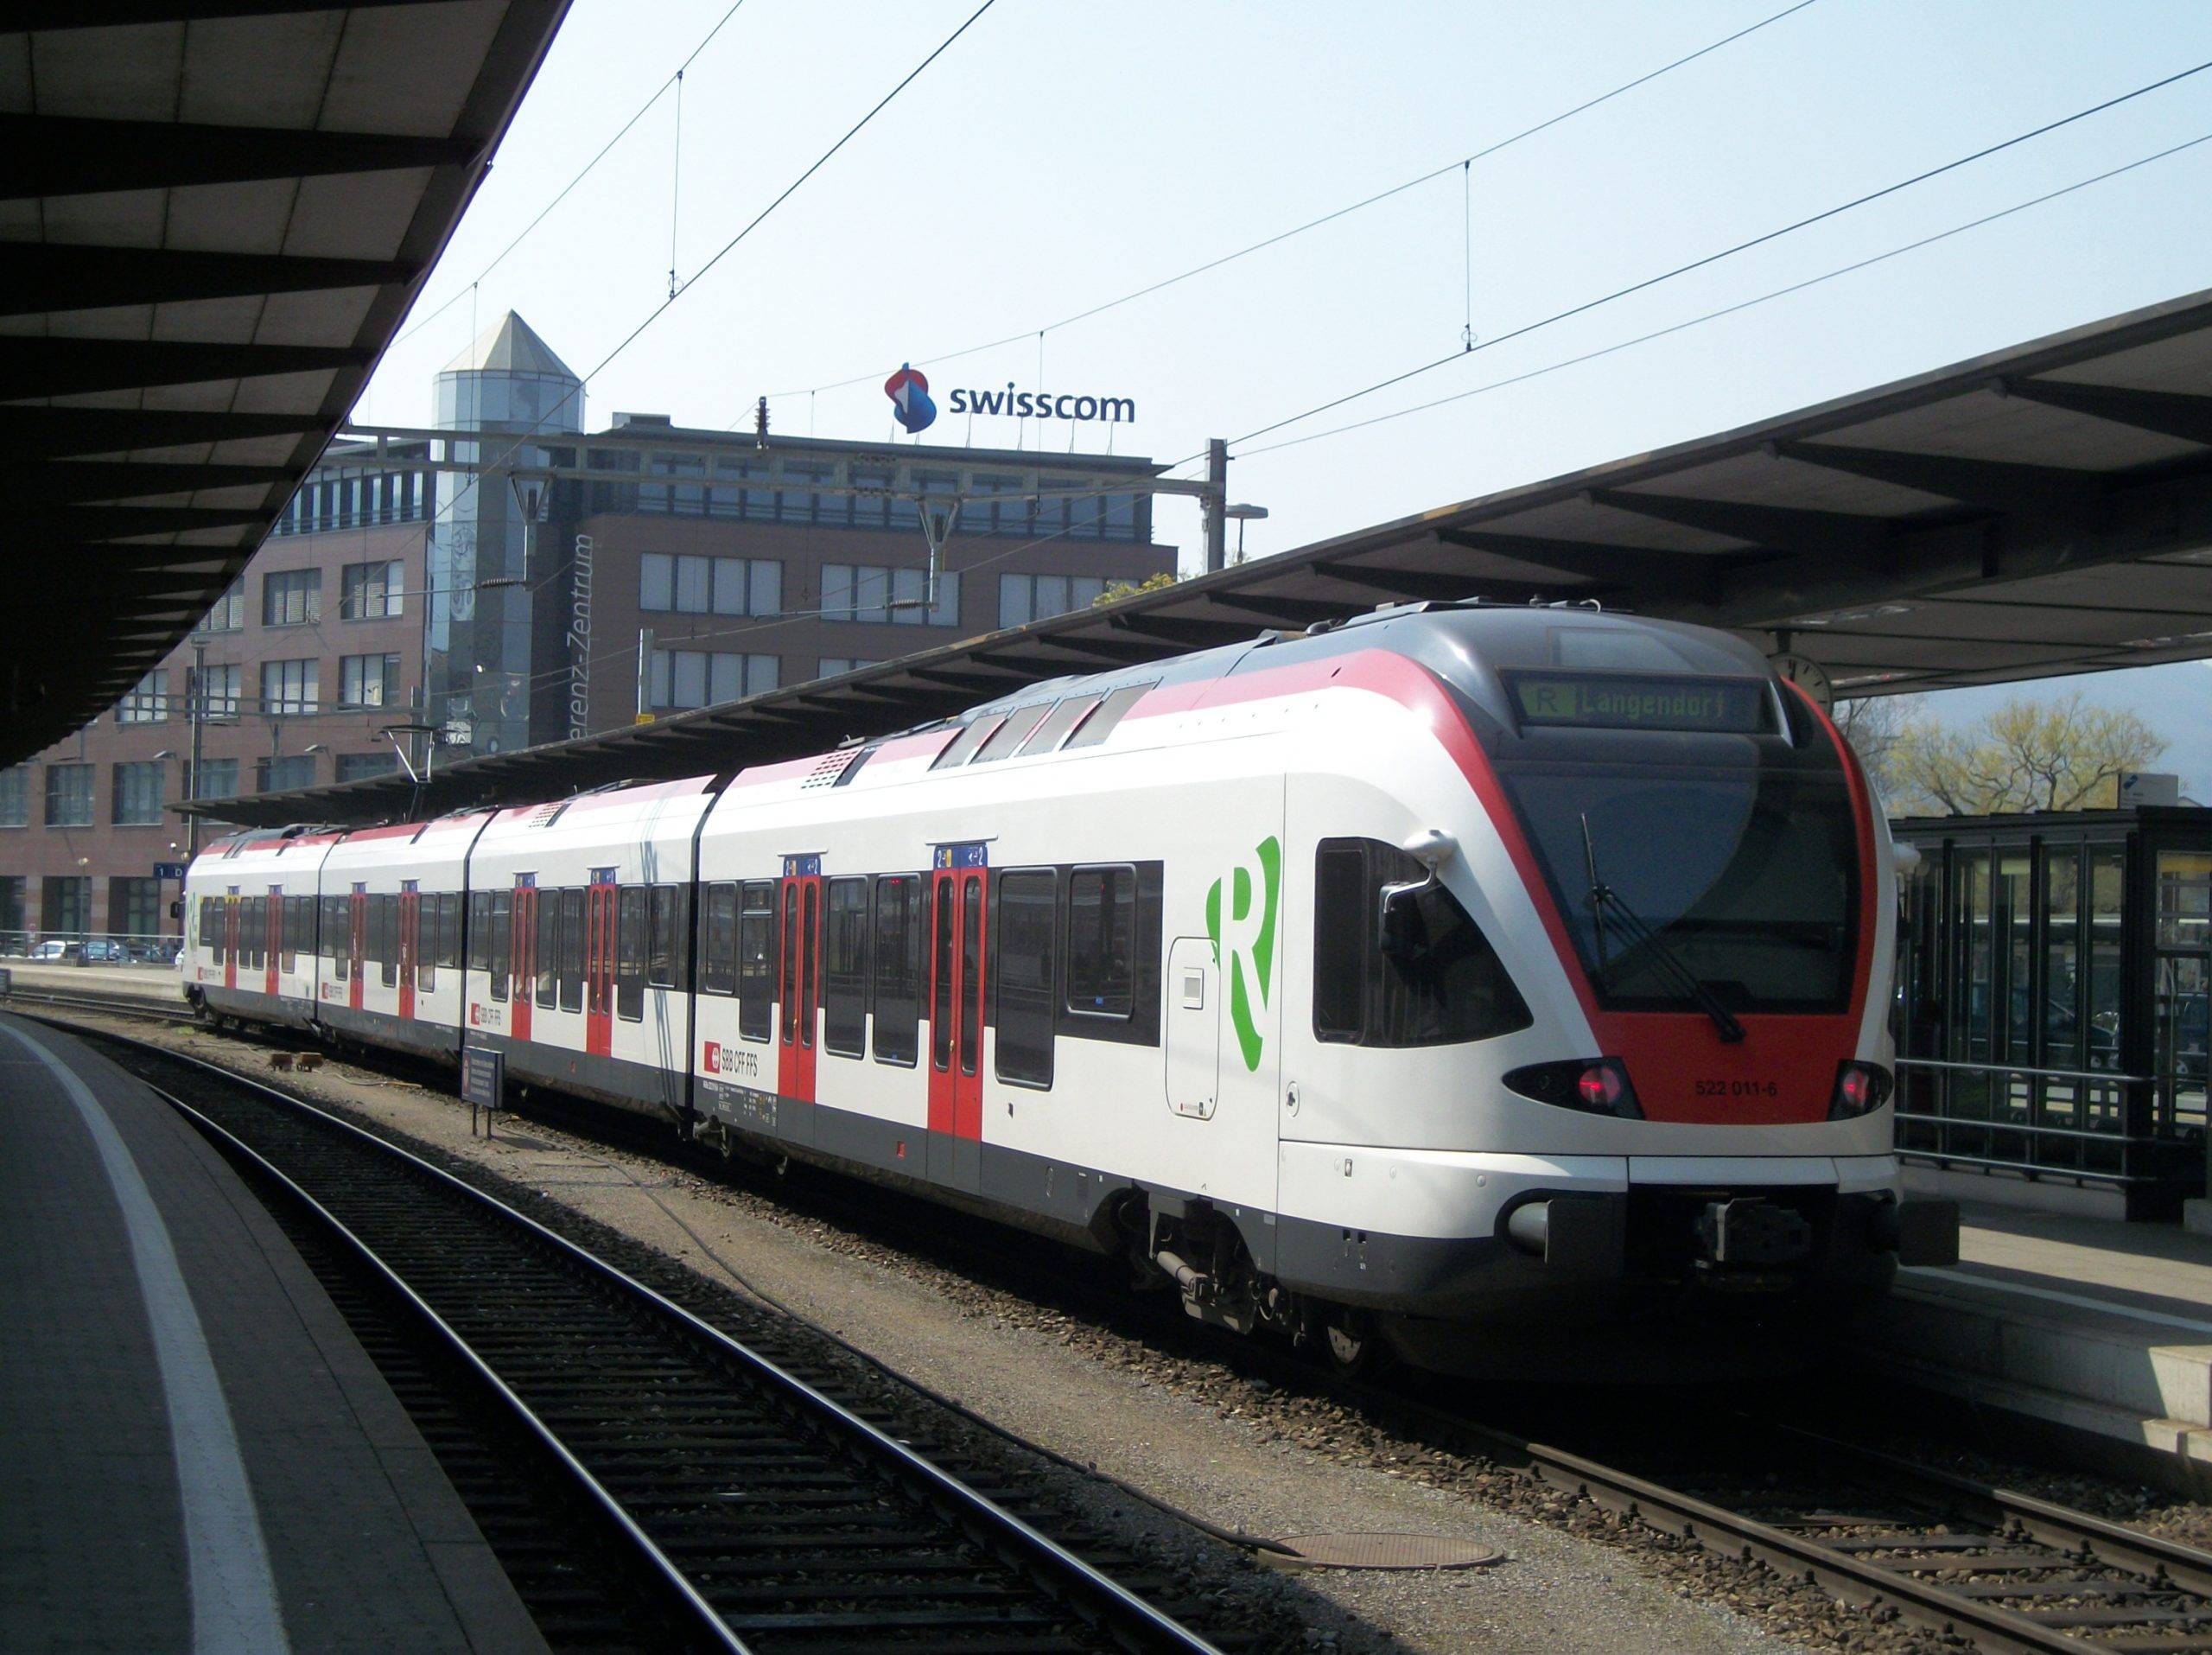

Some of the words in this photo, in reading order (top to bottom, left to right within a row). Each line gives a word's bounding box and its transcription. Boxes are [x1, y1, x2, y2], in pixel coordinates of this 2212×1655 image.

[950, 381, 1135, 423] swisscom
[1535, 686, 1559, 712] R
[721, 1047, 734, 1072] SBB
[734, 1050, 746, 1075] CFF
[746, 1052, 758, 1078] FFS
[1696, 1080, 1726, 1096] 522
[1732, 1081, 1778, 1097] 011-6
